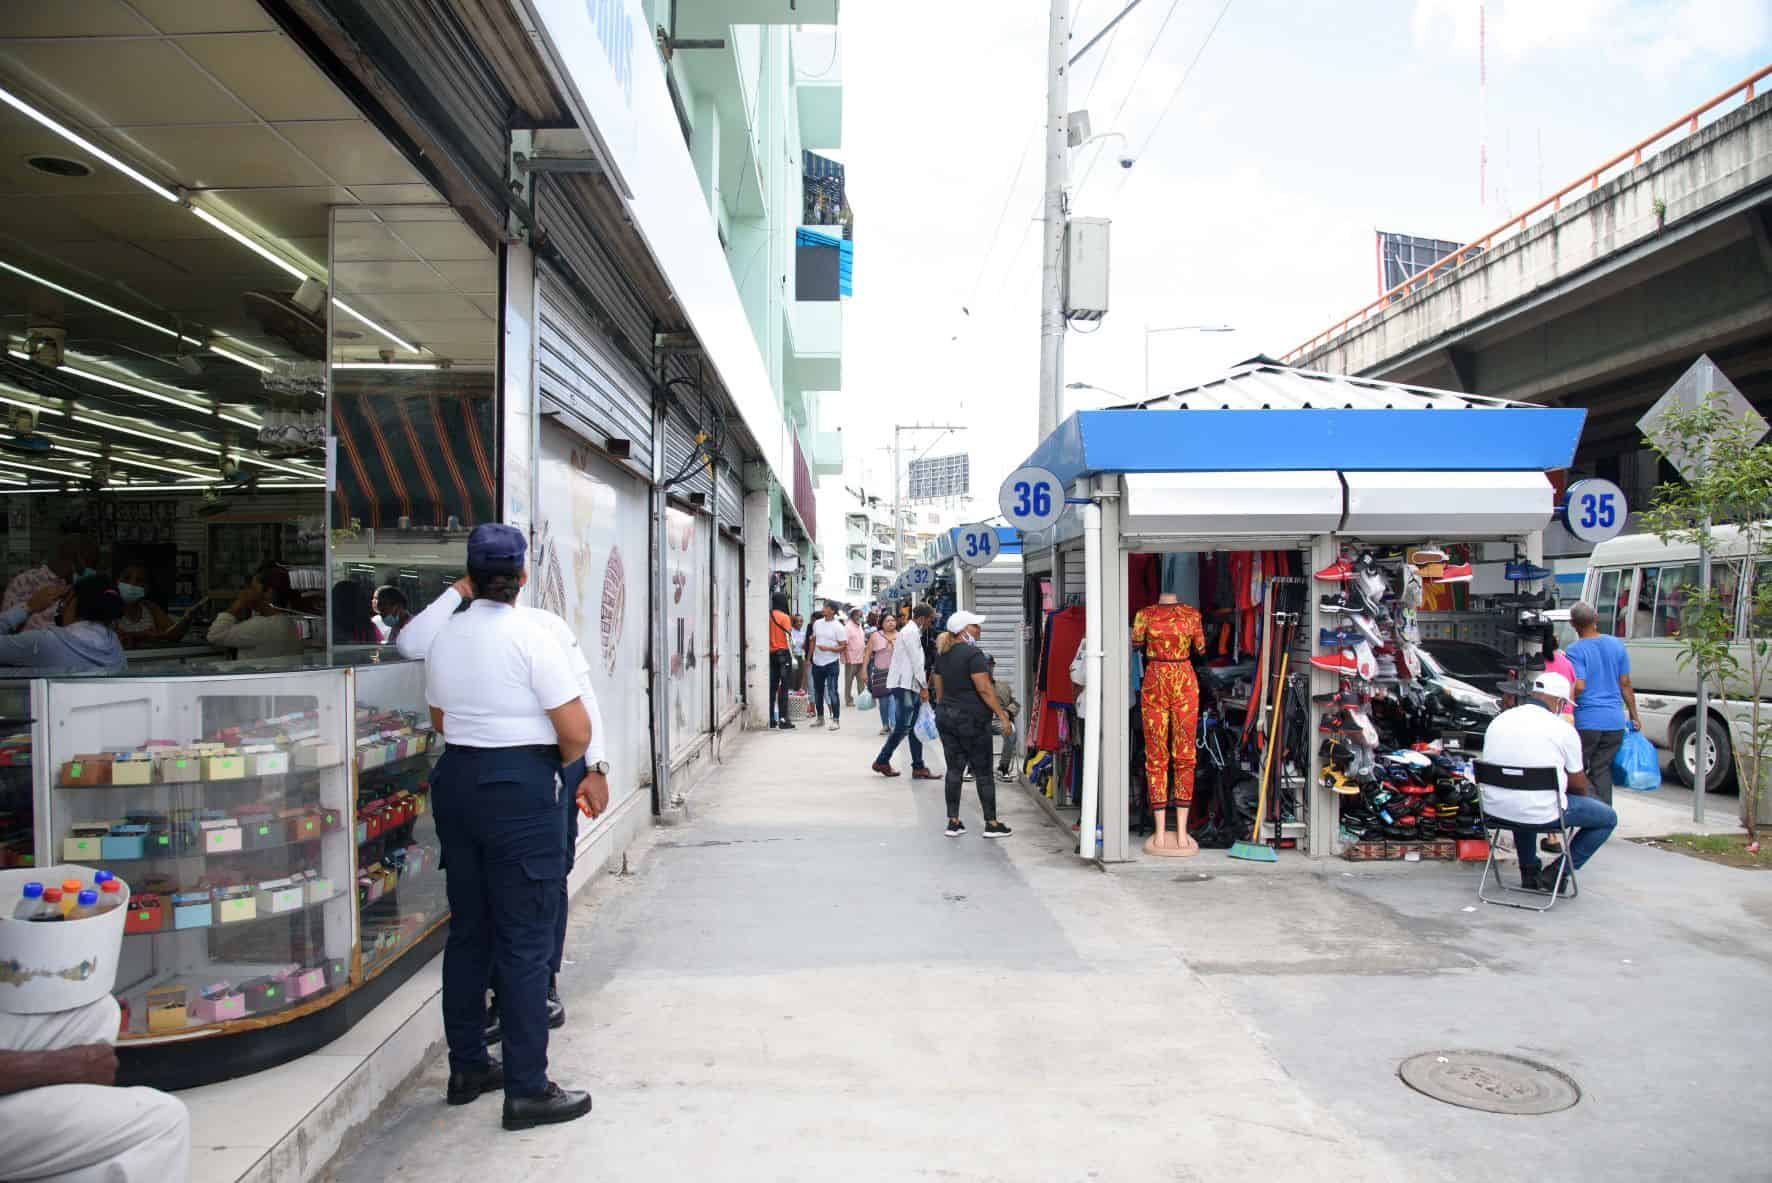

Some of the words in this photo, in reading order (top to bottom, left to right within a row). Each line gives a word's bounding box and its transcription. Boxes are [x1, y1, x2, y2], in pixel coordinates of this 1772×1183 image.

[1014, 481, 1051, 517] 36
[1581, 494, 1615, 528] 35
[965, 532, 991, 557] 34
[914, 569, 929, 584] 32
